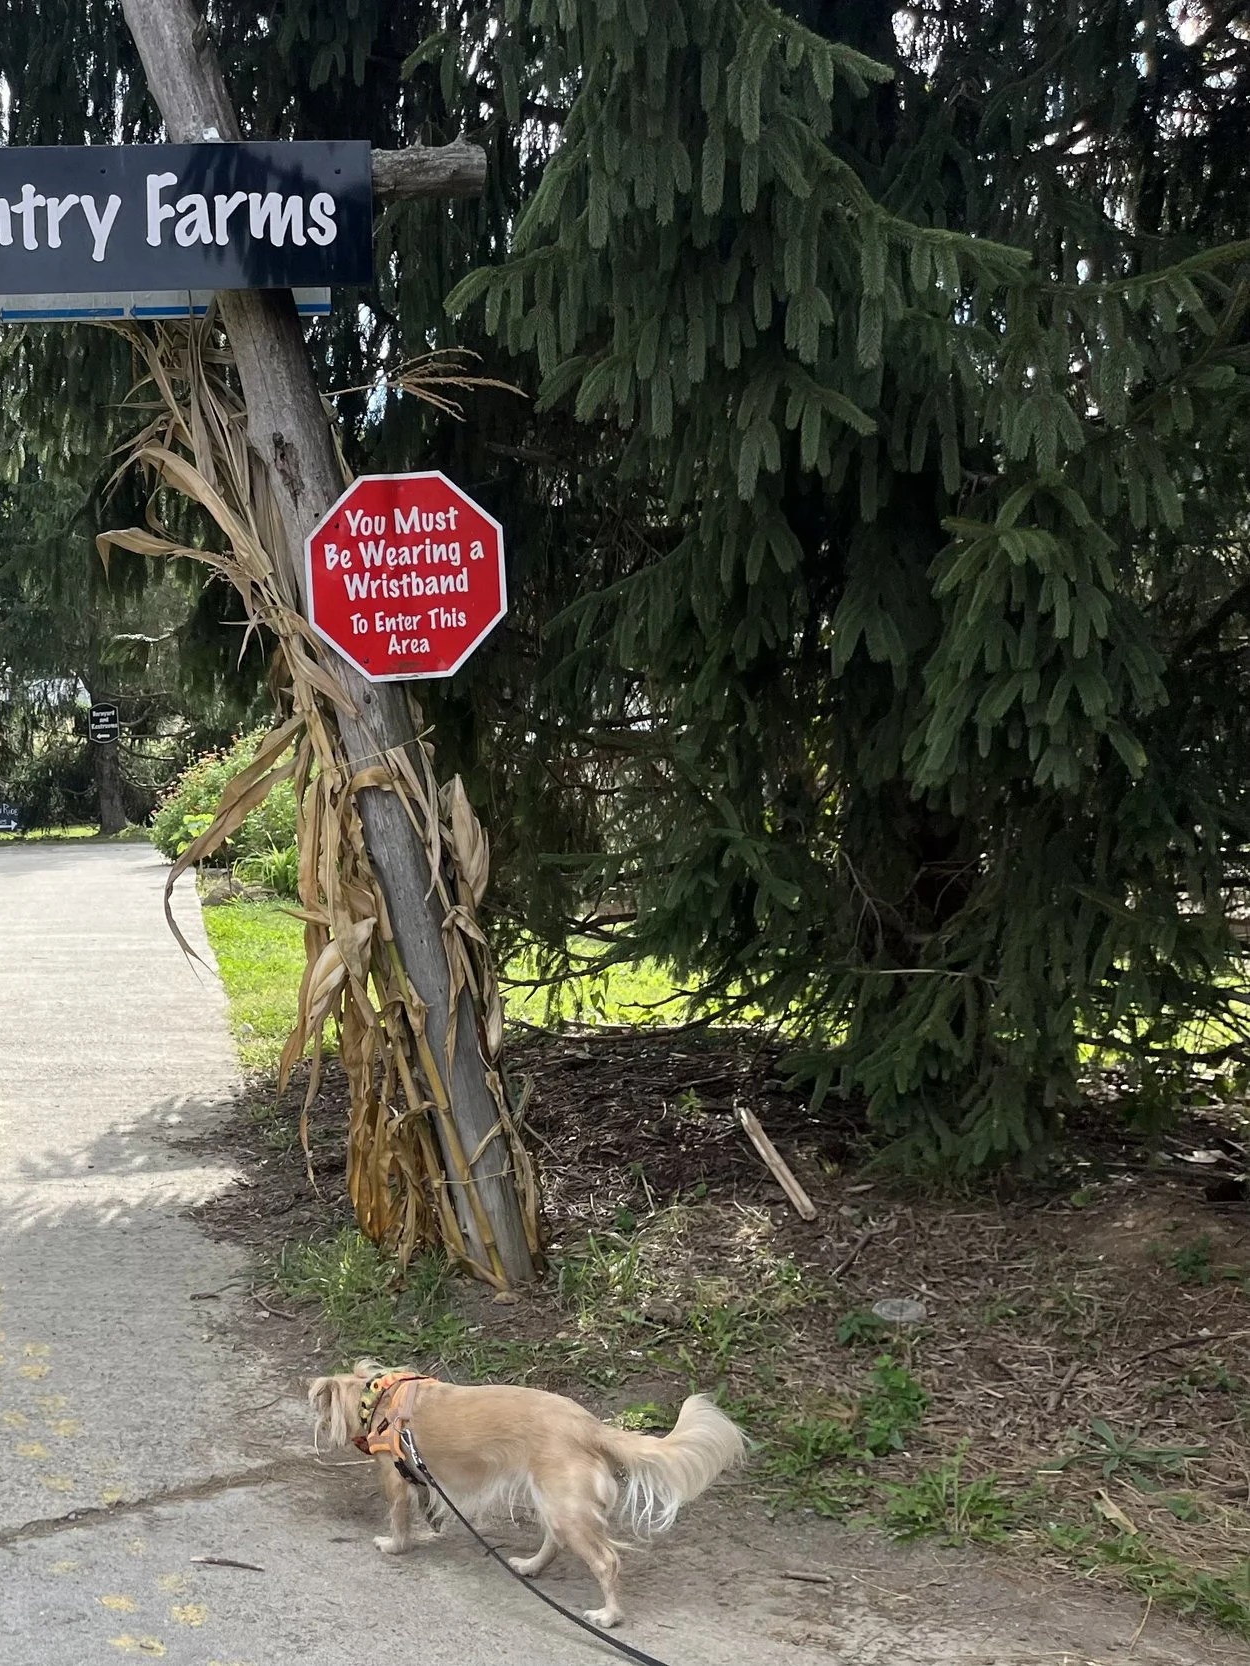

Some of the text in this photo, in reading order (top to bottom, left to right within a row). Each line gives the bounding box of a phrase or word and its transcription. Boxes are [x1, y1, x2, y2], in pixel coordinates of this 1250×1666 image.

[146, 171, 337, 247] Farms
[344, 505, 459, 537] You Must
[323, 538, 485, 571] Be Wearing a
[343, 566, 469, 602] Wristband
[349, 607, 467, 635] To Enter This
[387, 633, 431, 655] Area
